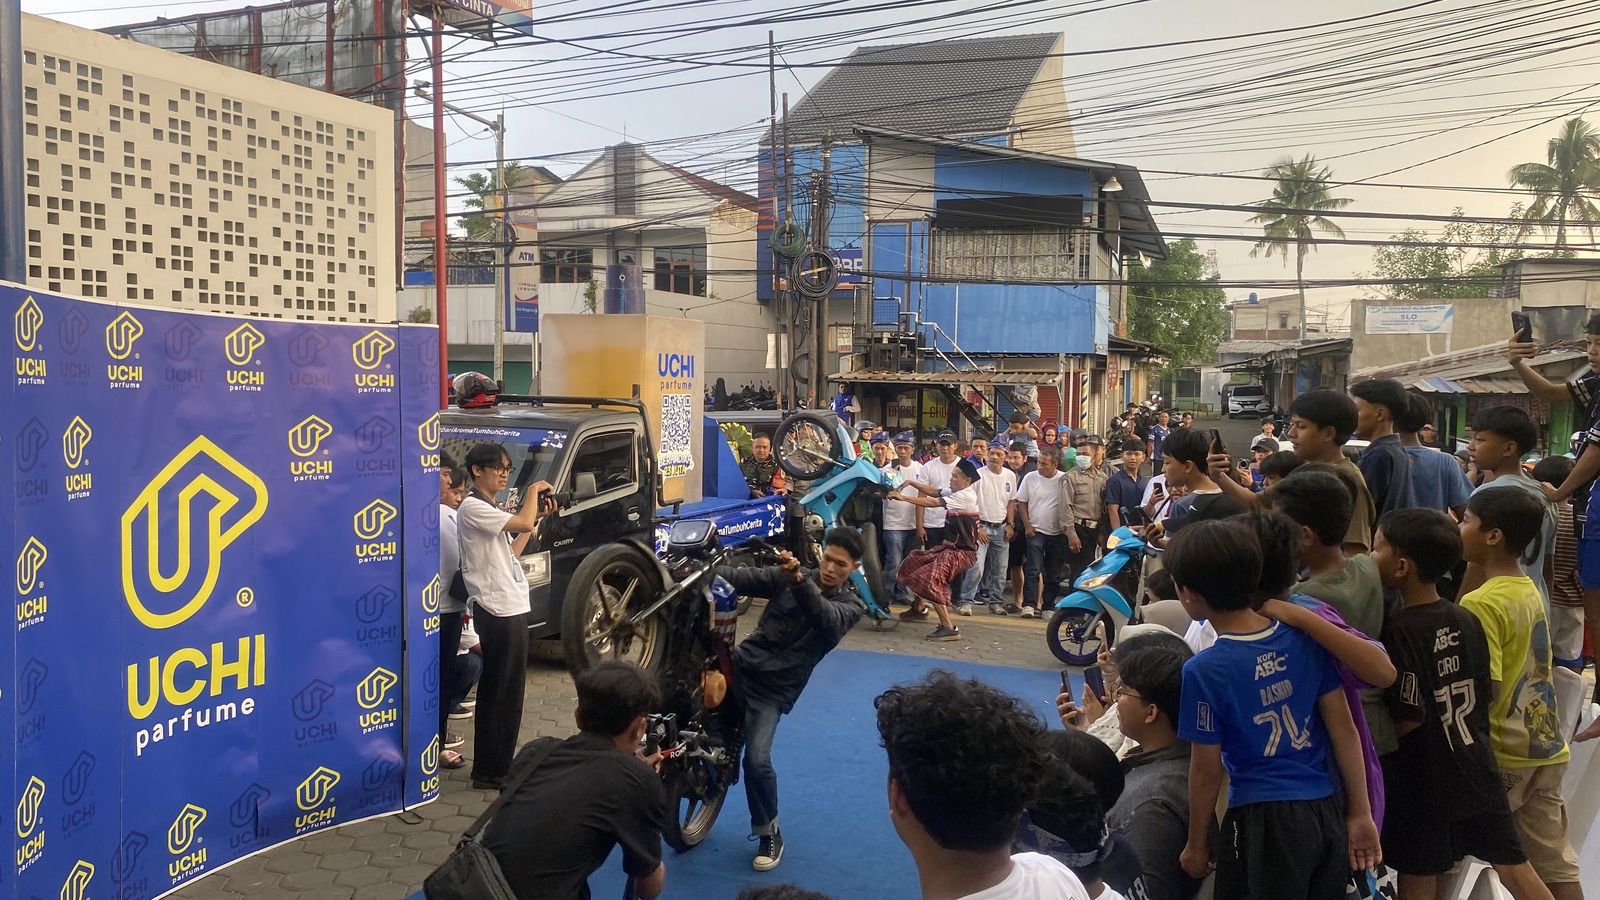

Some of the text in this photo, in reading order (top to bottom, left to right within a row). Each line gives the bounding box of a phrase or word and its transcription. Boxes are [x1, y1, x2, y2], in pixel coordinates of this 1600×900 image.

[462, 0, 494, 16] CINTA
[518, 251, 535, 262] ATM
[16, 357, 47, 377] UCHI
[107, 364, 143, 382] UCHI
[657, 352, 695, 378] UCHI
[18, 376, 45, 386] parfume
[110, 381, 140, 389] parfume
[226, 369, 265, 385] UCHI
[354, 373, 395, 387] UCHI
[660, 379, 692, 391] parfume
[229, 384, 262, 392] parfume
[358, 386, 392, 395] parfume
[290, 460, 333, 475] UCHI
[420, 454, 440, 467] UC
[65, 472, 92, 492] UCHI
[294, 474, 330, 482] parfume
[68, 491, 90, 502] parfume
[717, 518, 763, 536] maTumbuhCerita
[355, 541, 396, 558] UCHI
[553, 537, 575, 548] CARRY
[358, 555, 394, 565] parfume
[16, 595, 48, 622] UCHI
[18, 615, 45, 632] parfume
[356, 626, 397, 642] UCHI
[1433, 631, 1460, 653] ABC
[1256, 651, 1276, 664] KOPI
[1437, 655, 1460, 677] CIRO
[127, 633, 266, 720] UCHI
[1254, 656, 1288, 681] ABC
[1259, 679, 1294, 707] RASHID
[359, 708, 397, 729] UCHI
[1433, 678, 1477, 752] 77
[135, 697, 255, 757] parfume
[362, 722, 394, 735] parfume
[294, 806, 337, 829] UCHI
[296, 820, 332, 835] parfume
[16, 830, 46, 866] UCHI
[18, 851, 43, 877] parfume
[168, 847, 207, 878] UCHI
[172, 865, 205, 886] parfume
